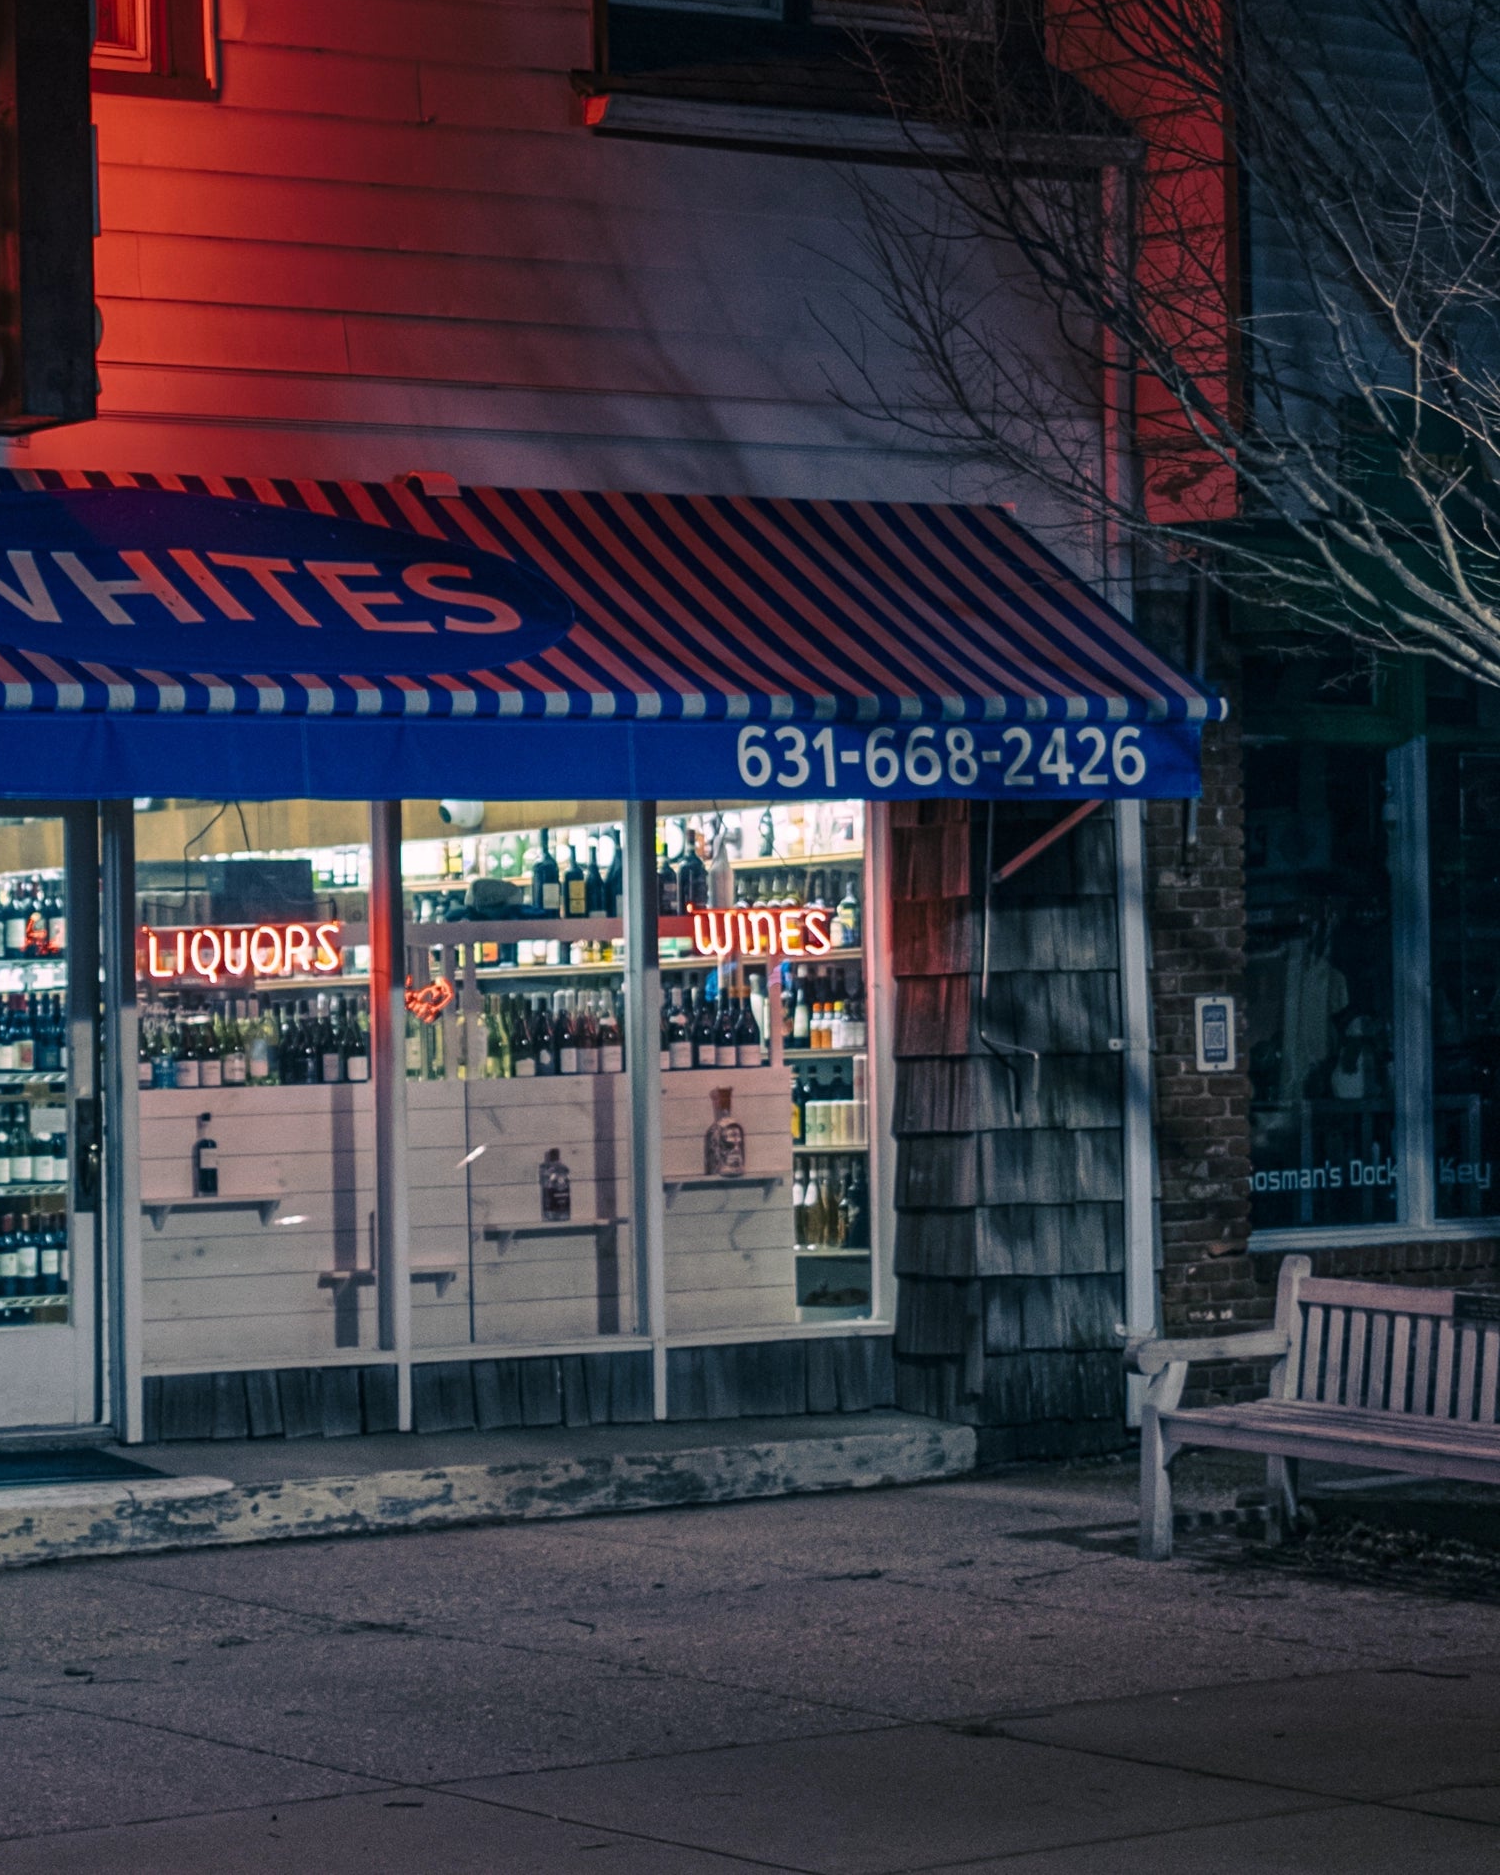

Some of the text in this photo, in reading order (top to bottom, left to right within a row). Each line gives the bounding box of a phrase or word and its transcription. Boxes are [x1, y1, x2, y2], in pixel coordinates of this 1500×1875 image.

[736, 725, 1147, 788] 631-668-2426
[147, 922, 342, 984] LIQUORS
[692, 910, 832, 956] WINES
[1349, 1156, 1399, 1187] Dock
